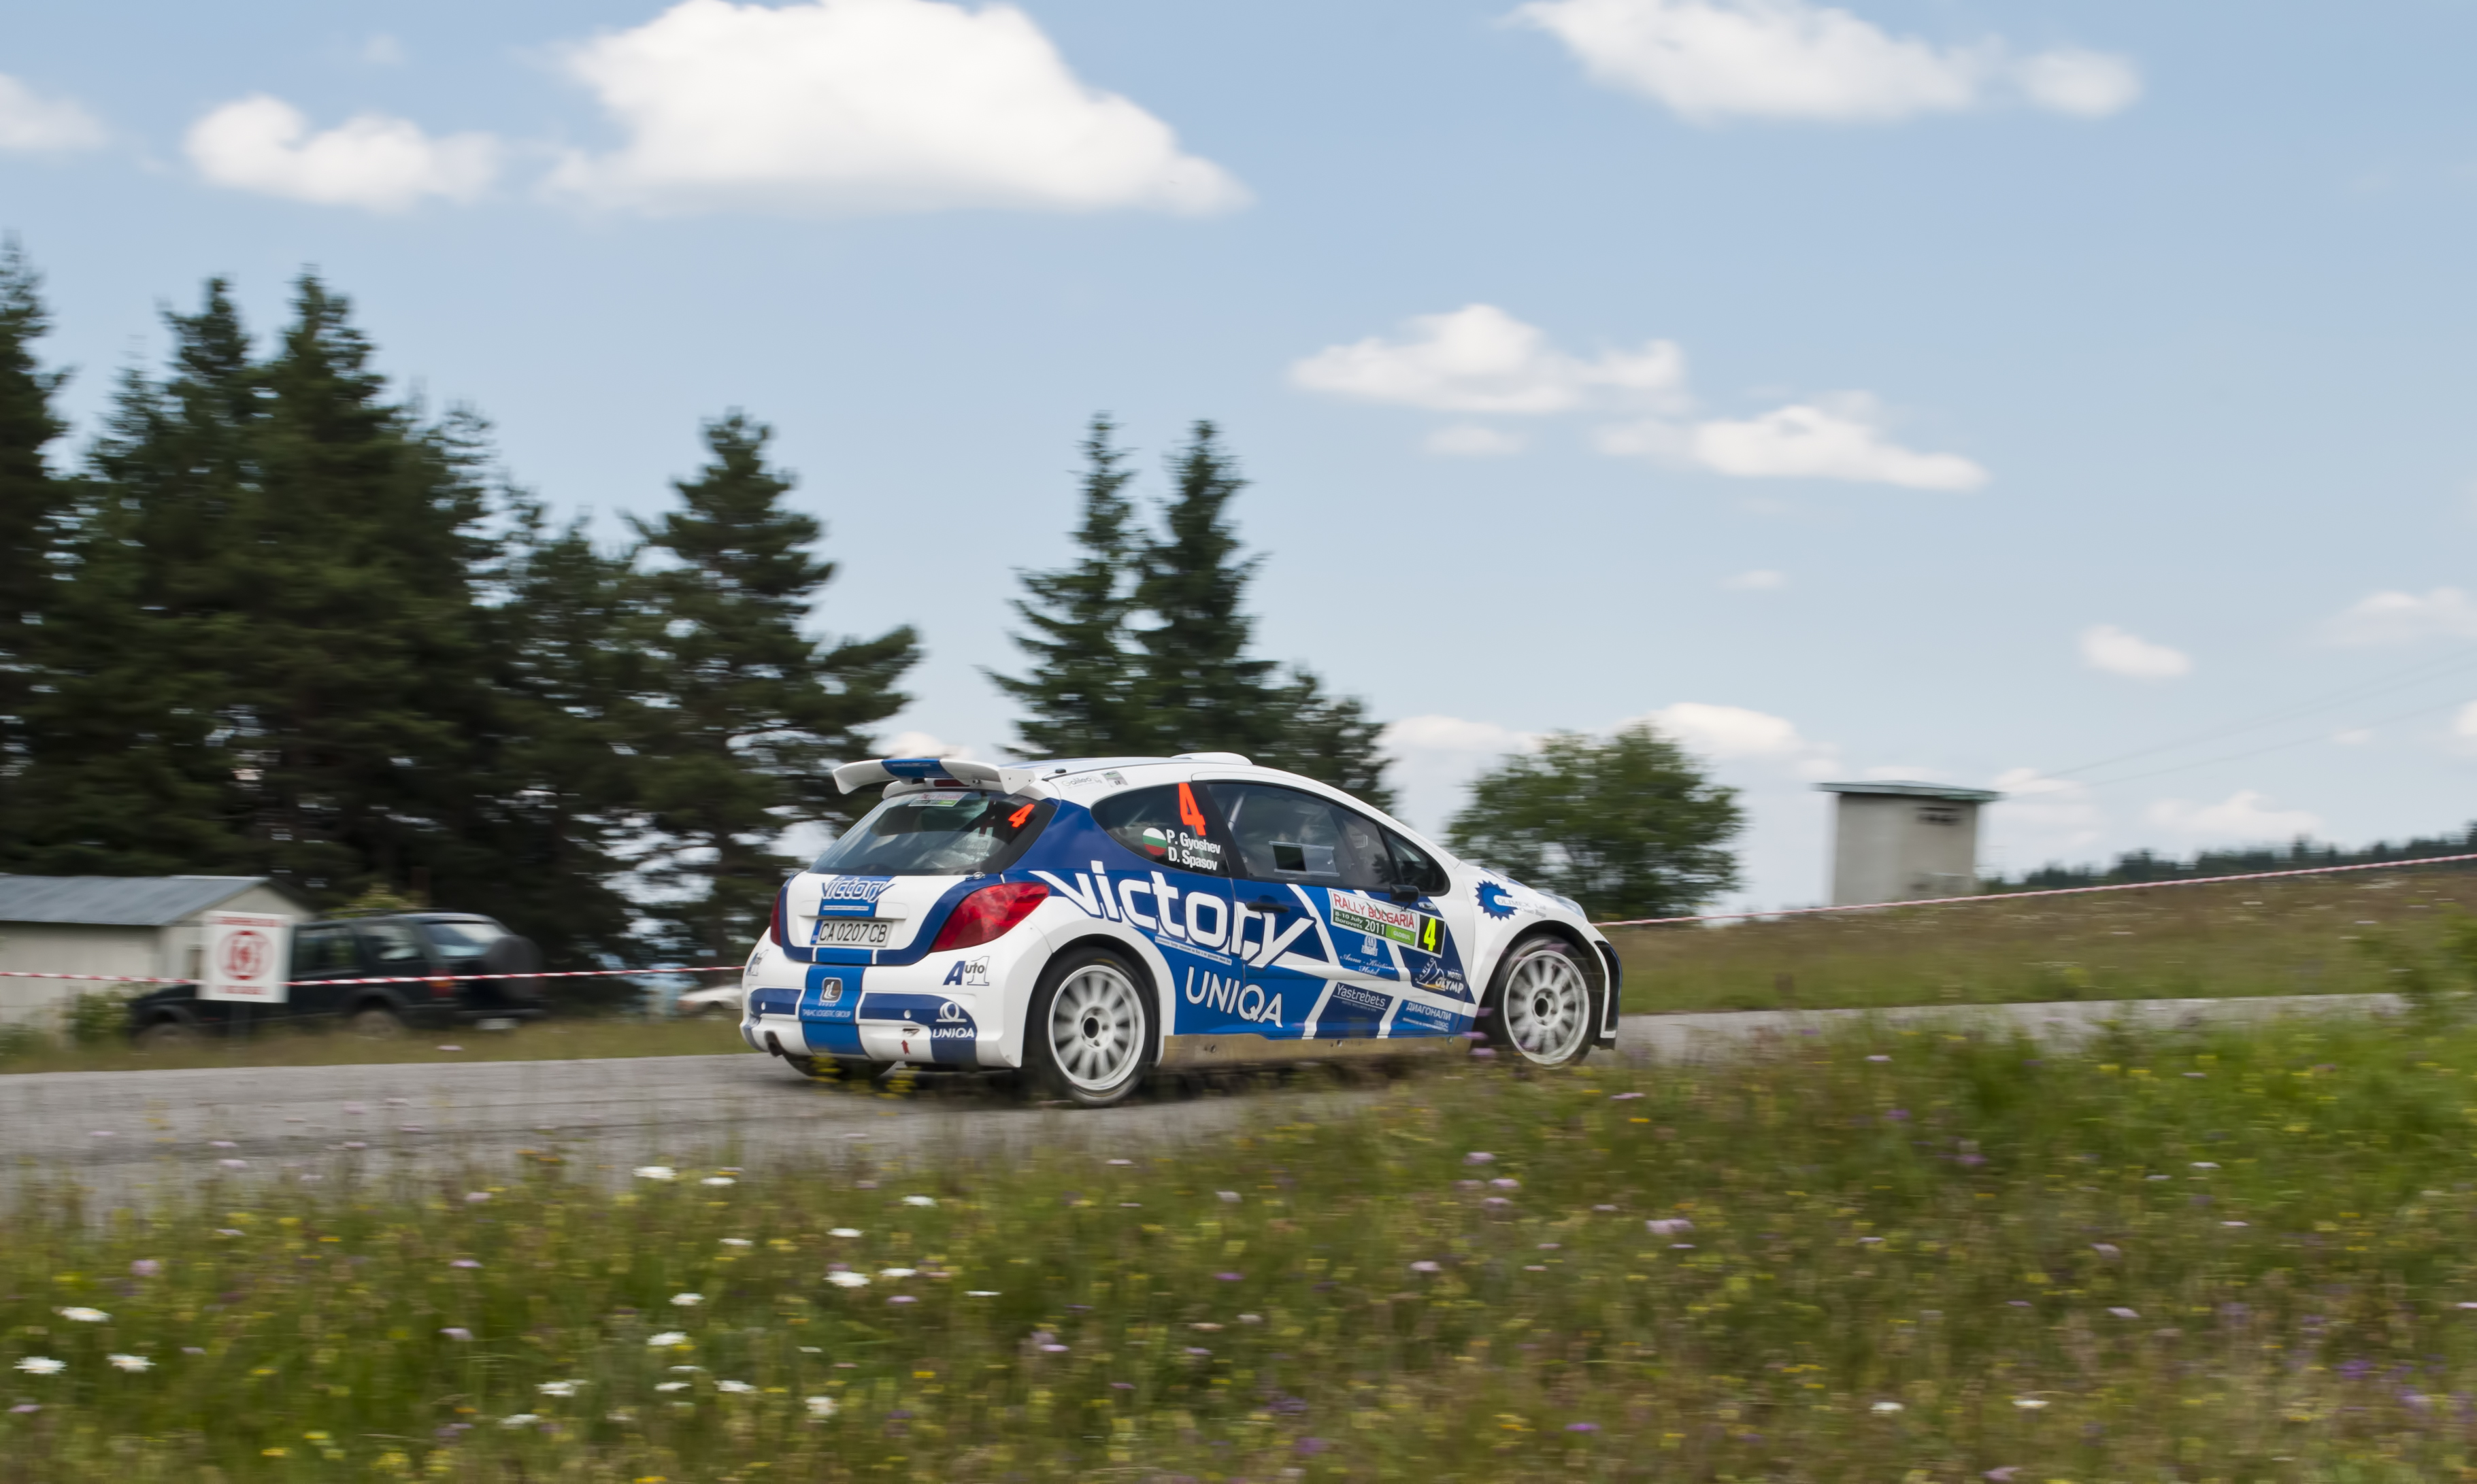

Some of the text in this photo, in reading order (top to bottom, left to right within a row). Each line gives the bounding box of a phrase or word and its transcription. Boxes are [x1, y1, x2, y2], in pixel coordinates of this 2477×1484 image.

[1008, 803, 1035, 828] 4
[1178, 781, 1206, 836] 4
[1166, 828, 1221, 854] P. Gyoshev
[1168, 846, 1218, 871] D. Spasov
[1333, 893, 1414, 929] RALLY BULGARIA
[1497, 898, 1531, 907] OLIMEX
[1335, 916, 1384, 935] Borovets 2011
[1350, 915, 1363, 924] July
[836, 923, 869, 941] 0207
[1423, 918, 1436, 951] 4
[1340, 954, 1361, 964] Anna
[1337, 983, 1386, 1007] Yastrebets
[1435, 977, 1464, 994] OLYMP
[1185, 966, 1284, 1028] UNIQA
[1406, 1002, 1452, 1022] ДИАГОНАЛИ
[932, 1027, 975, 1039] UNIQA
